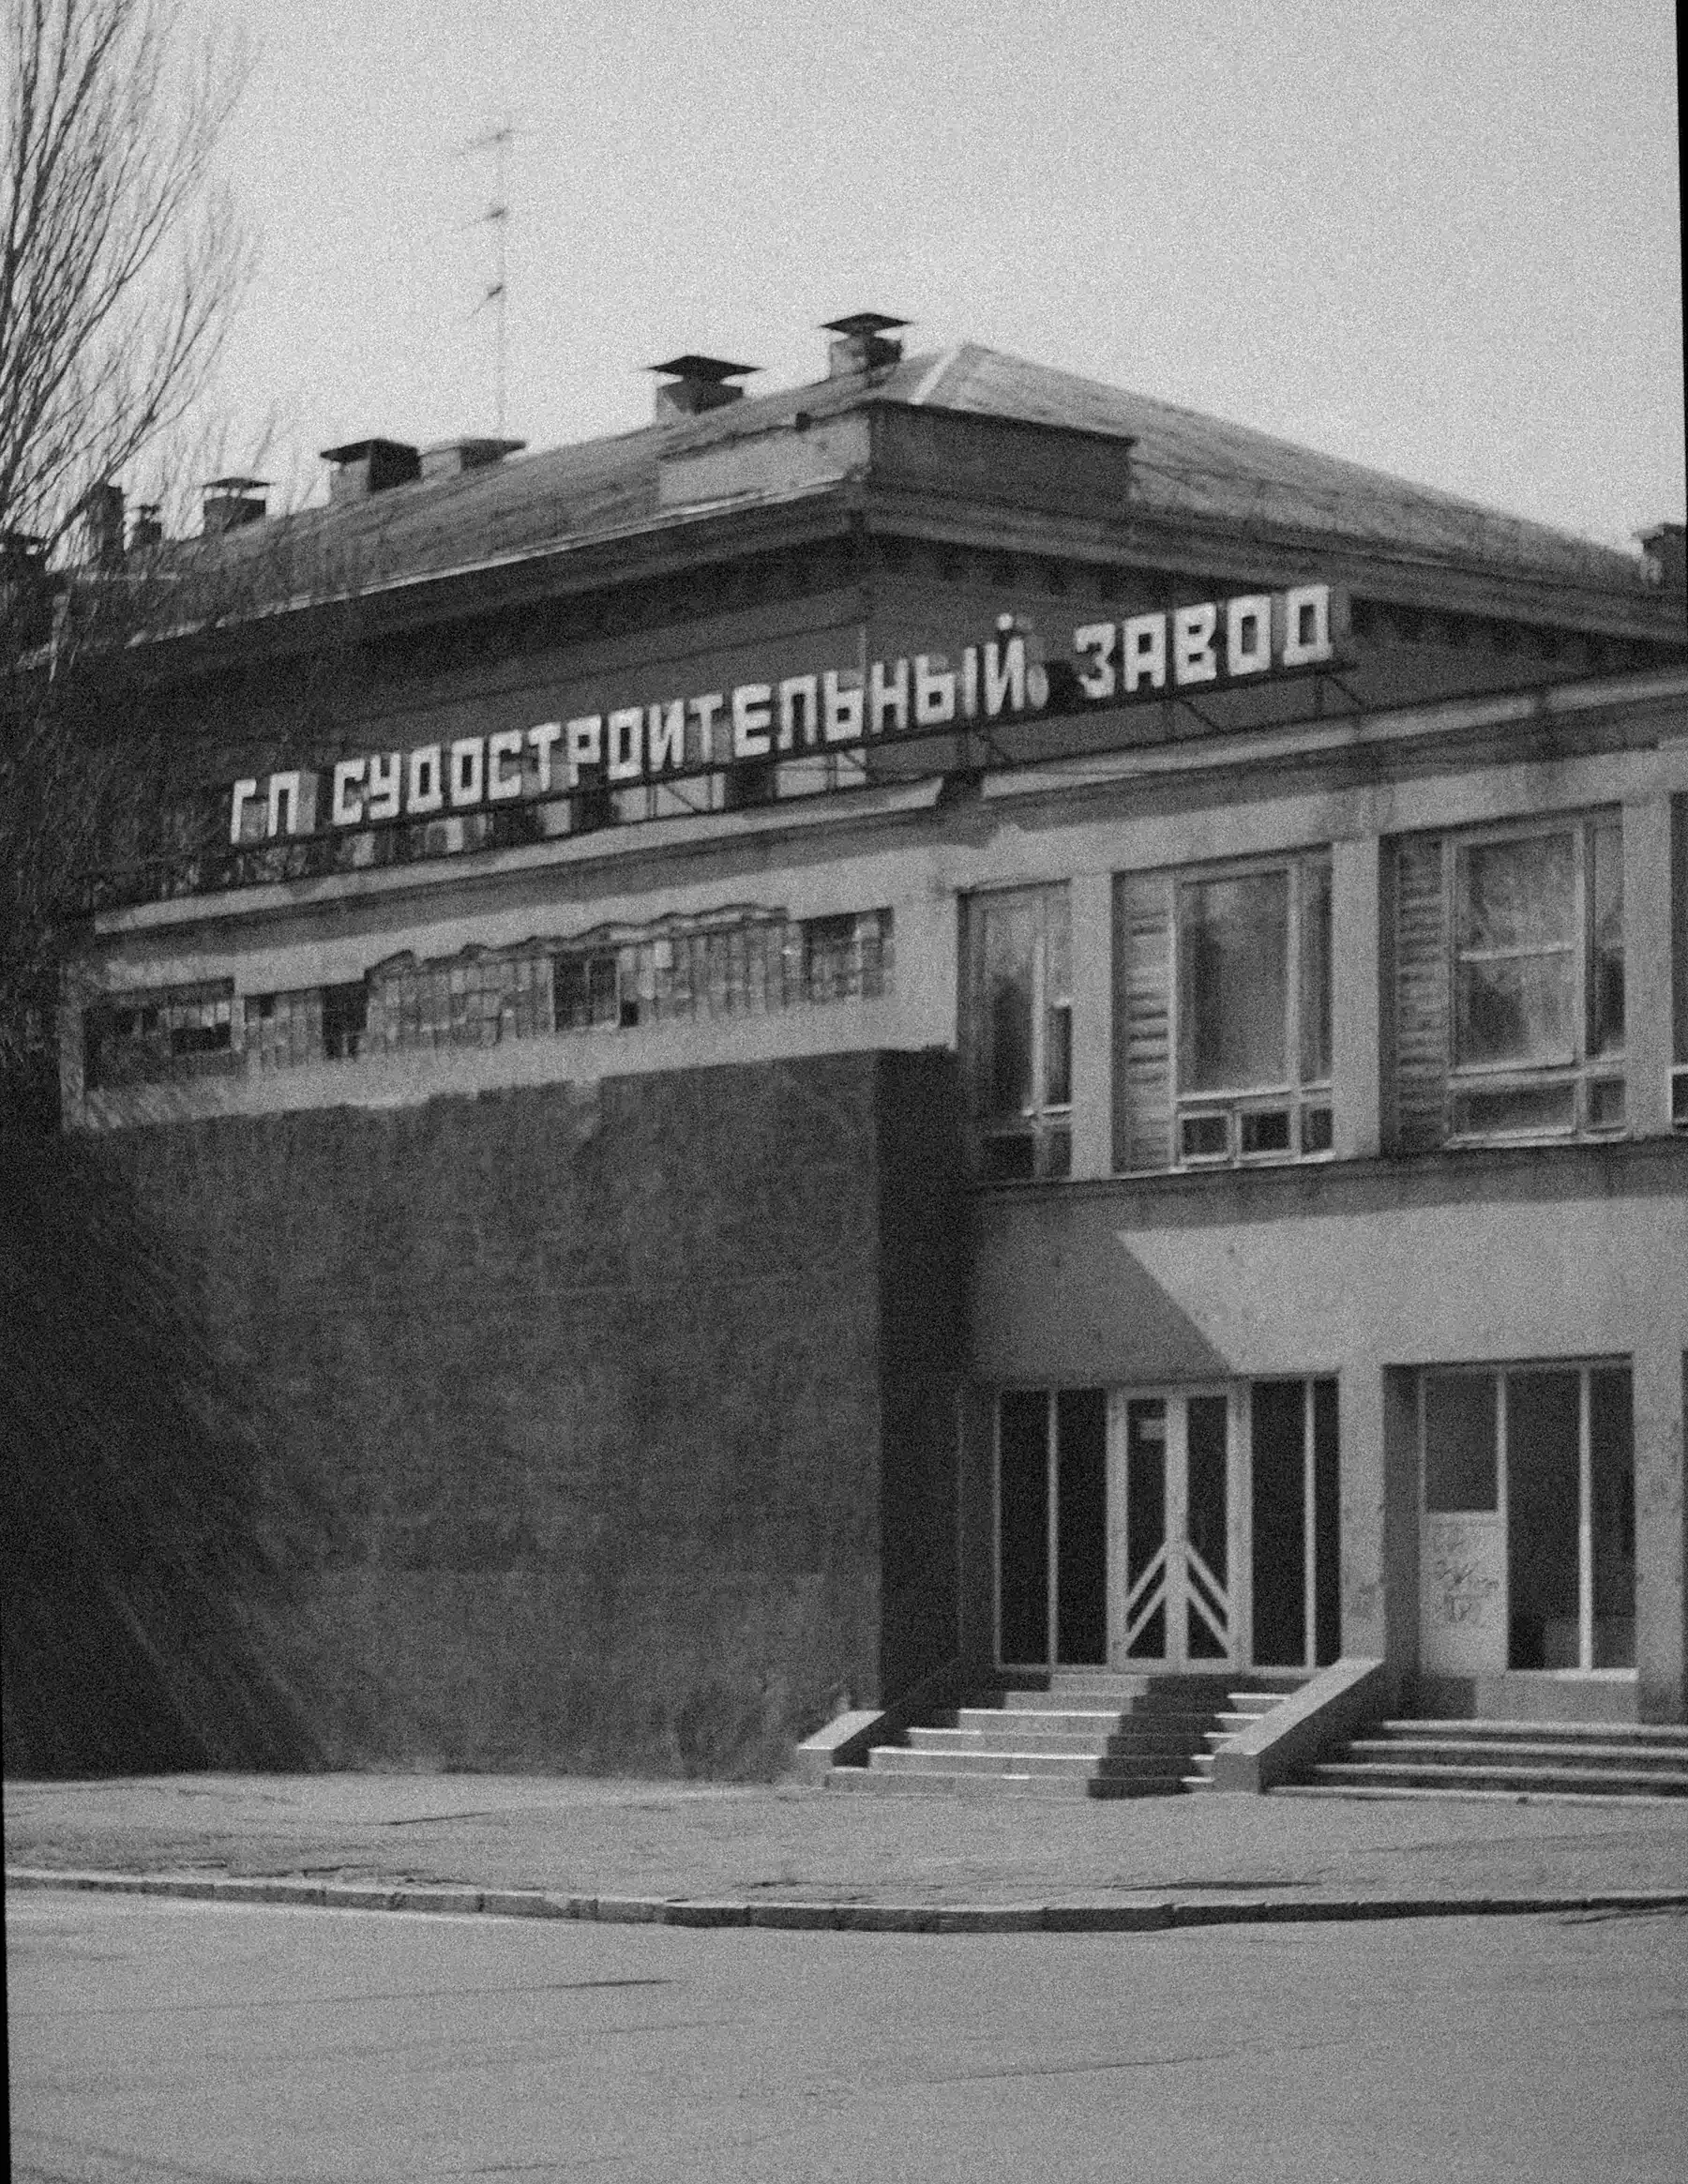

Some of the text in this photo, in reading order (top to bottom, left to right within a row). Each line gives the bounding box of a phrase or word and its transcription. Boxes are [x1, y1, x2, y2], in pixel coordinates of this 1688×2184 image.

[231, 583, 1333, 844] ГП СУДОСТРОИТЕЛЬНЫЙ ЗАВОД
